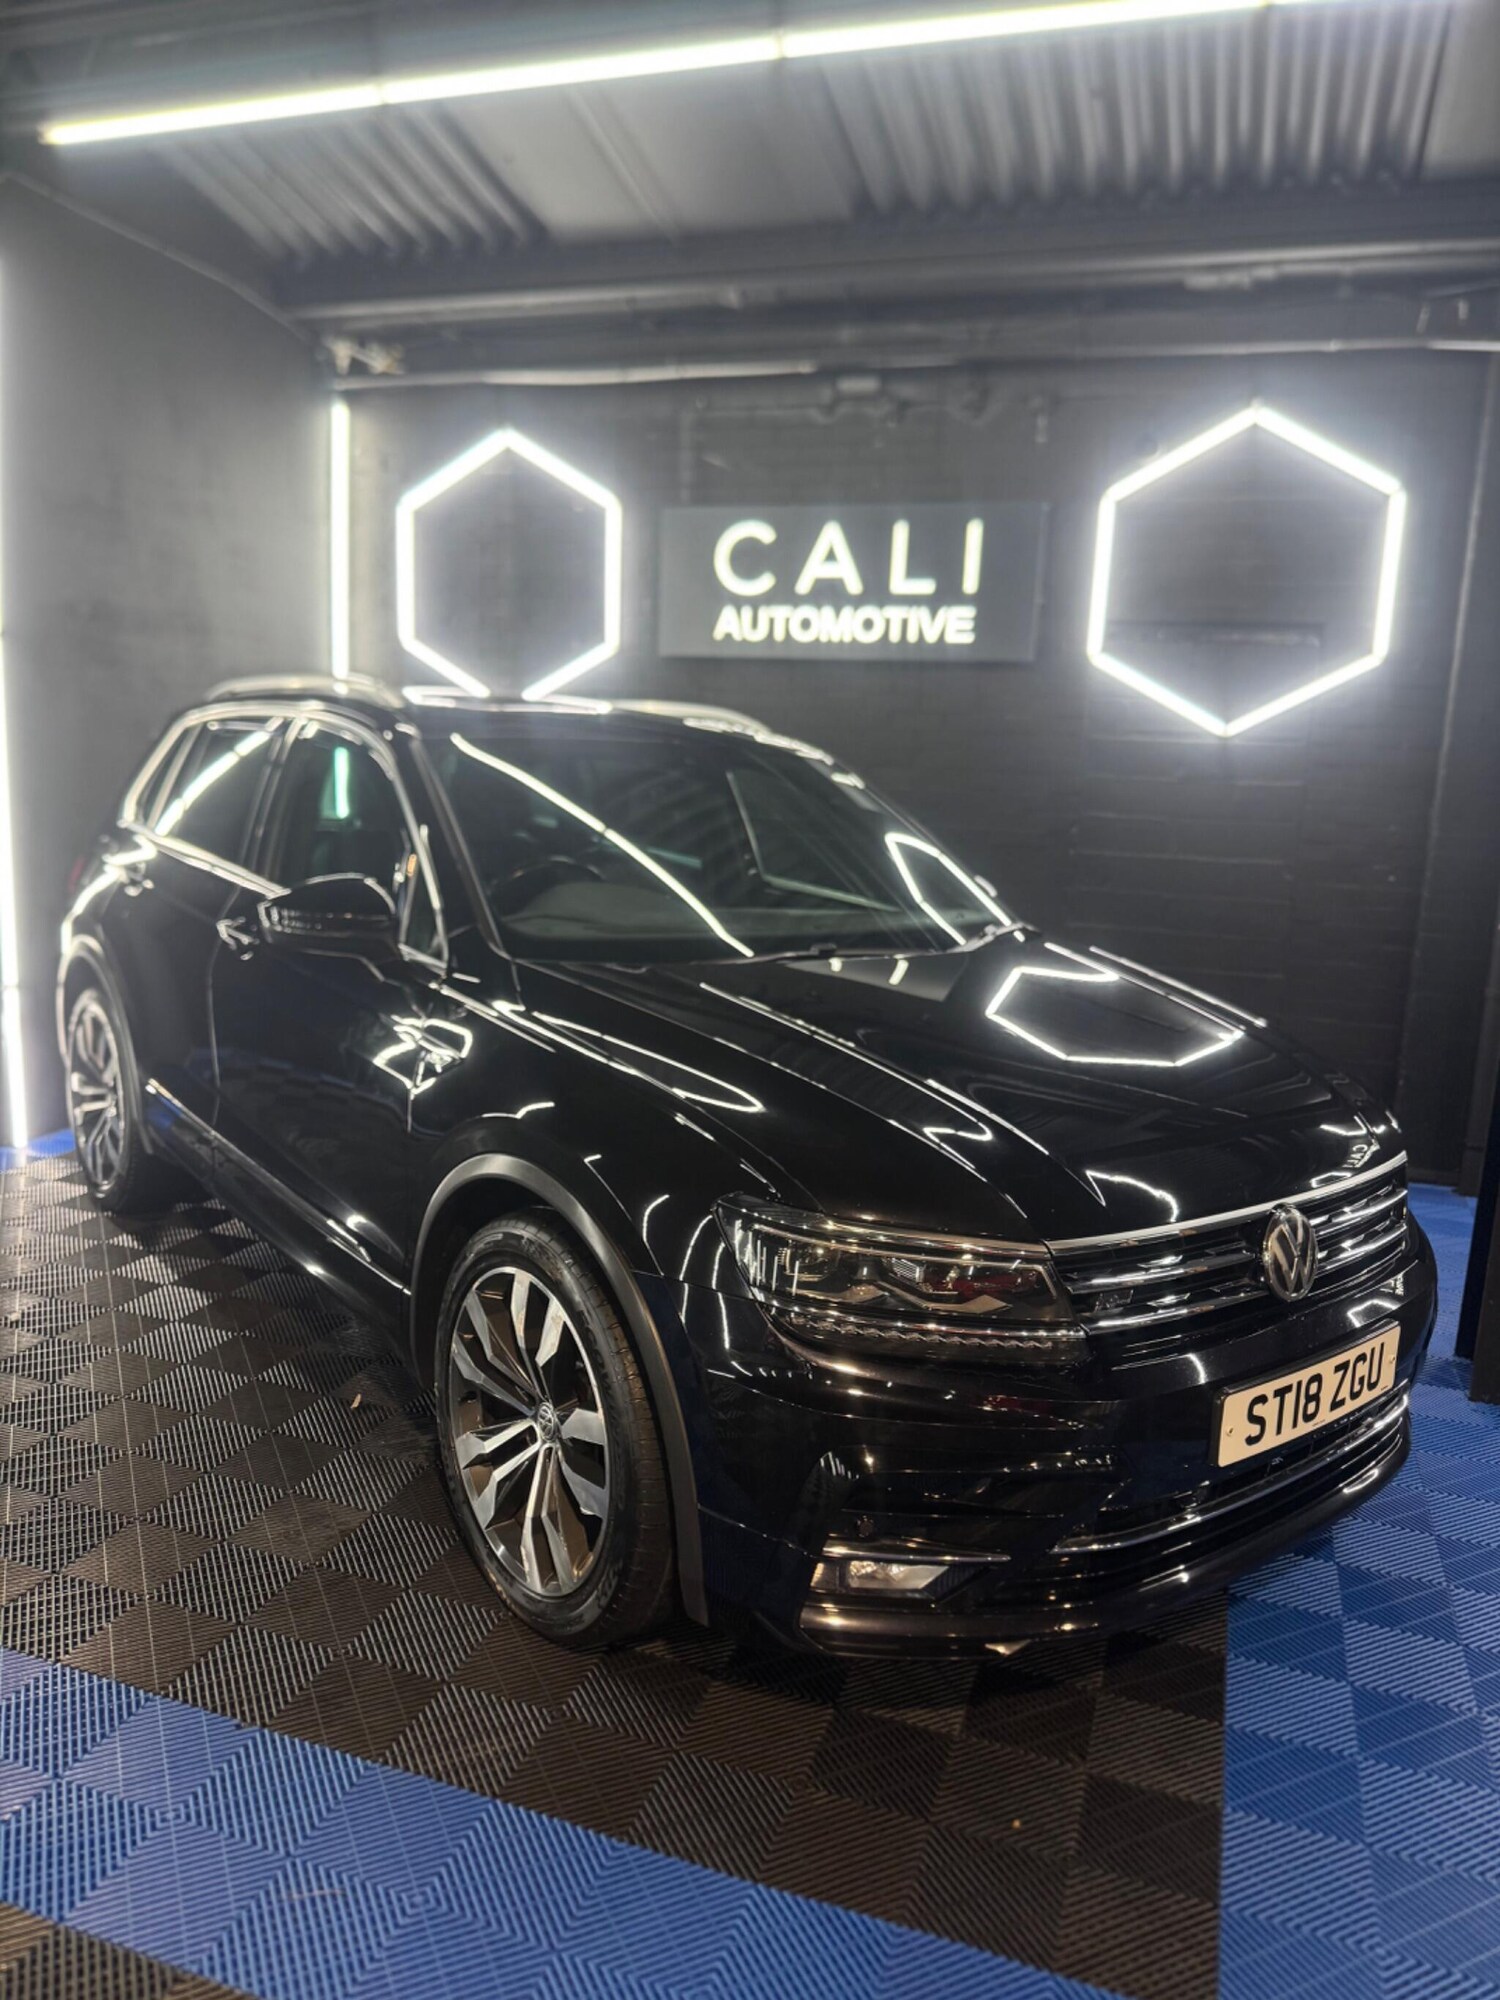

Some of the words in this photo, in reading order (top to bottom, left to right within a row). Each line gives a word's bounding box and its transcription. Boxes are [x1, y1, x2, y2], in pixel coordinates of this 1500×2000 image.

[712, 518, 984, 597] CALI
[712, 604, 977, 644] AUTOMOTIVE
[1244, 1372, 1323, 1447] ST18
[1329, 1341, 1385, 1413] ZGU
